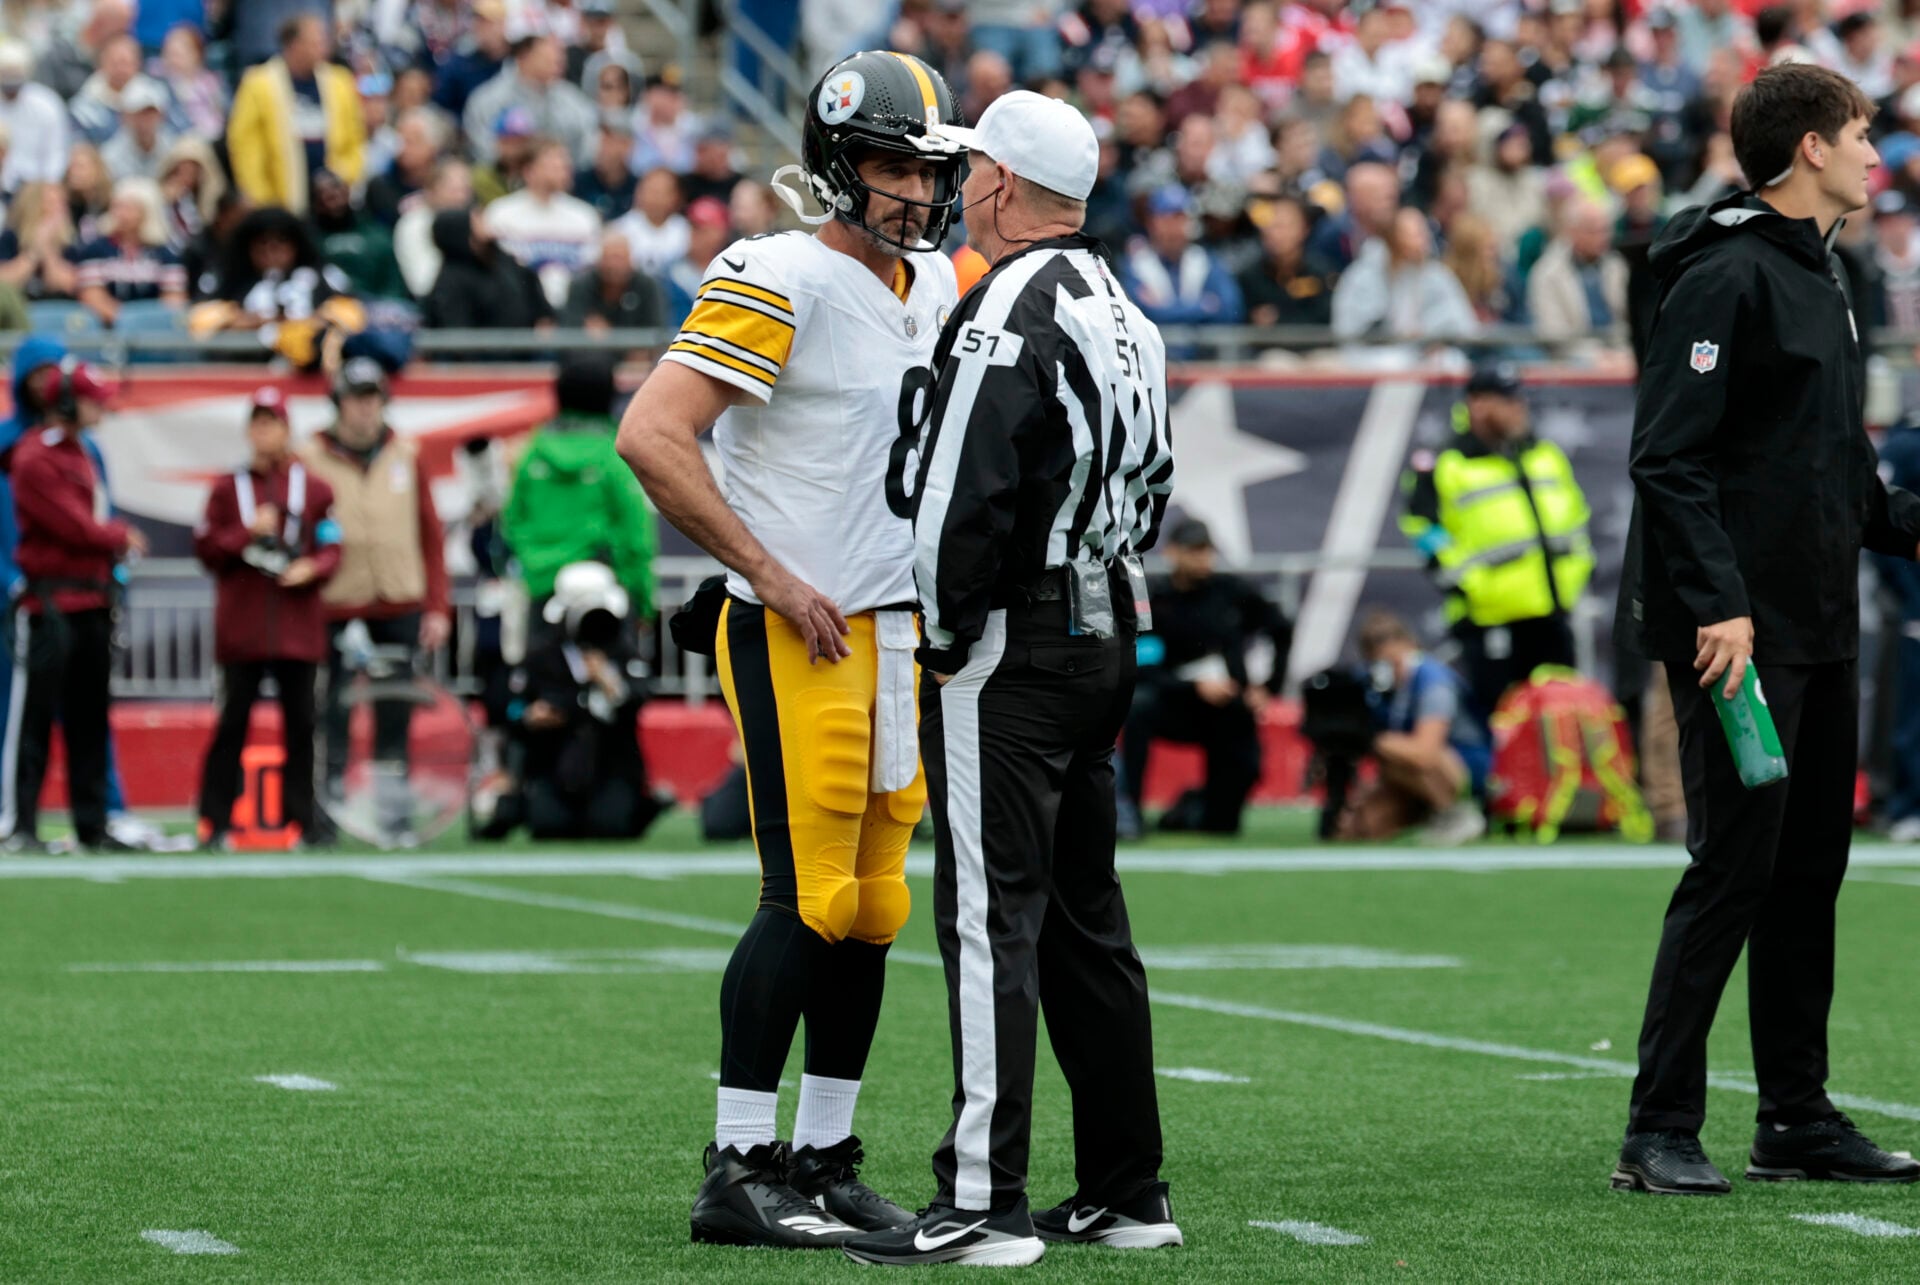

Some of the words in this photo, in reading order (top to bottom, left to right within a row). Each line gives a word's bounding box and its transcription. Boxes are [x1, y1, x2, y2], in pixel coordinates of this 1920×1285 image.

[1110, 303, 1128, 334] R
[962, 328, 1000, 357] 51
[1115, 338, 1142, 381] 51
[884, 365, 938, 519] 8
